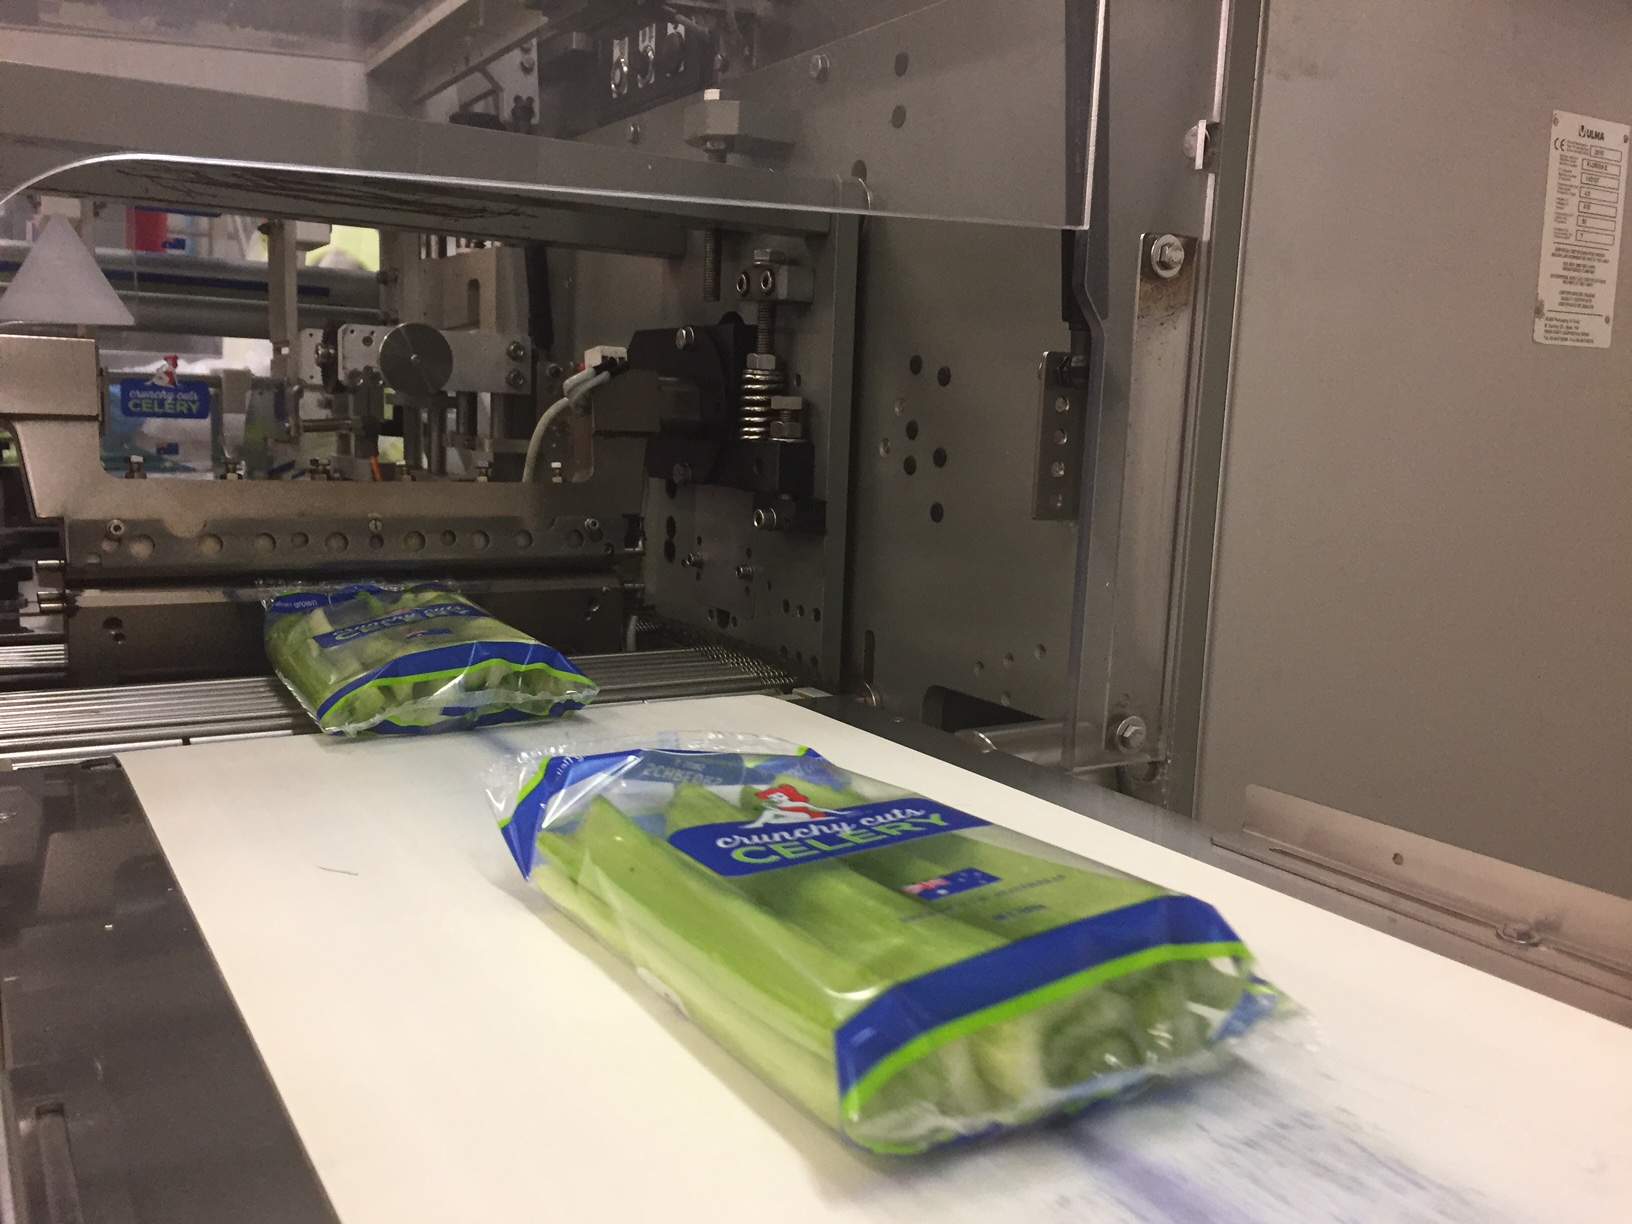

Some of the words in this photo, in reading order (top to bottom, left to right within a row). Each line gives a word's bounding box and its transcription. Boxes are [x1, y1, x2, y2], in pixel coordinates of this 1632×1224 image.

[1586, 129, 1605, 141] ULMA
[127, 398, 200, 414] CELERY
[715, 818, 858, 848] crunchy
[860, 807, 926, 827] cuts
[731, 813, 949, 864] CELERY
